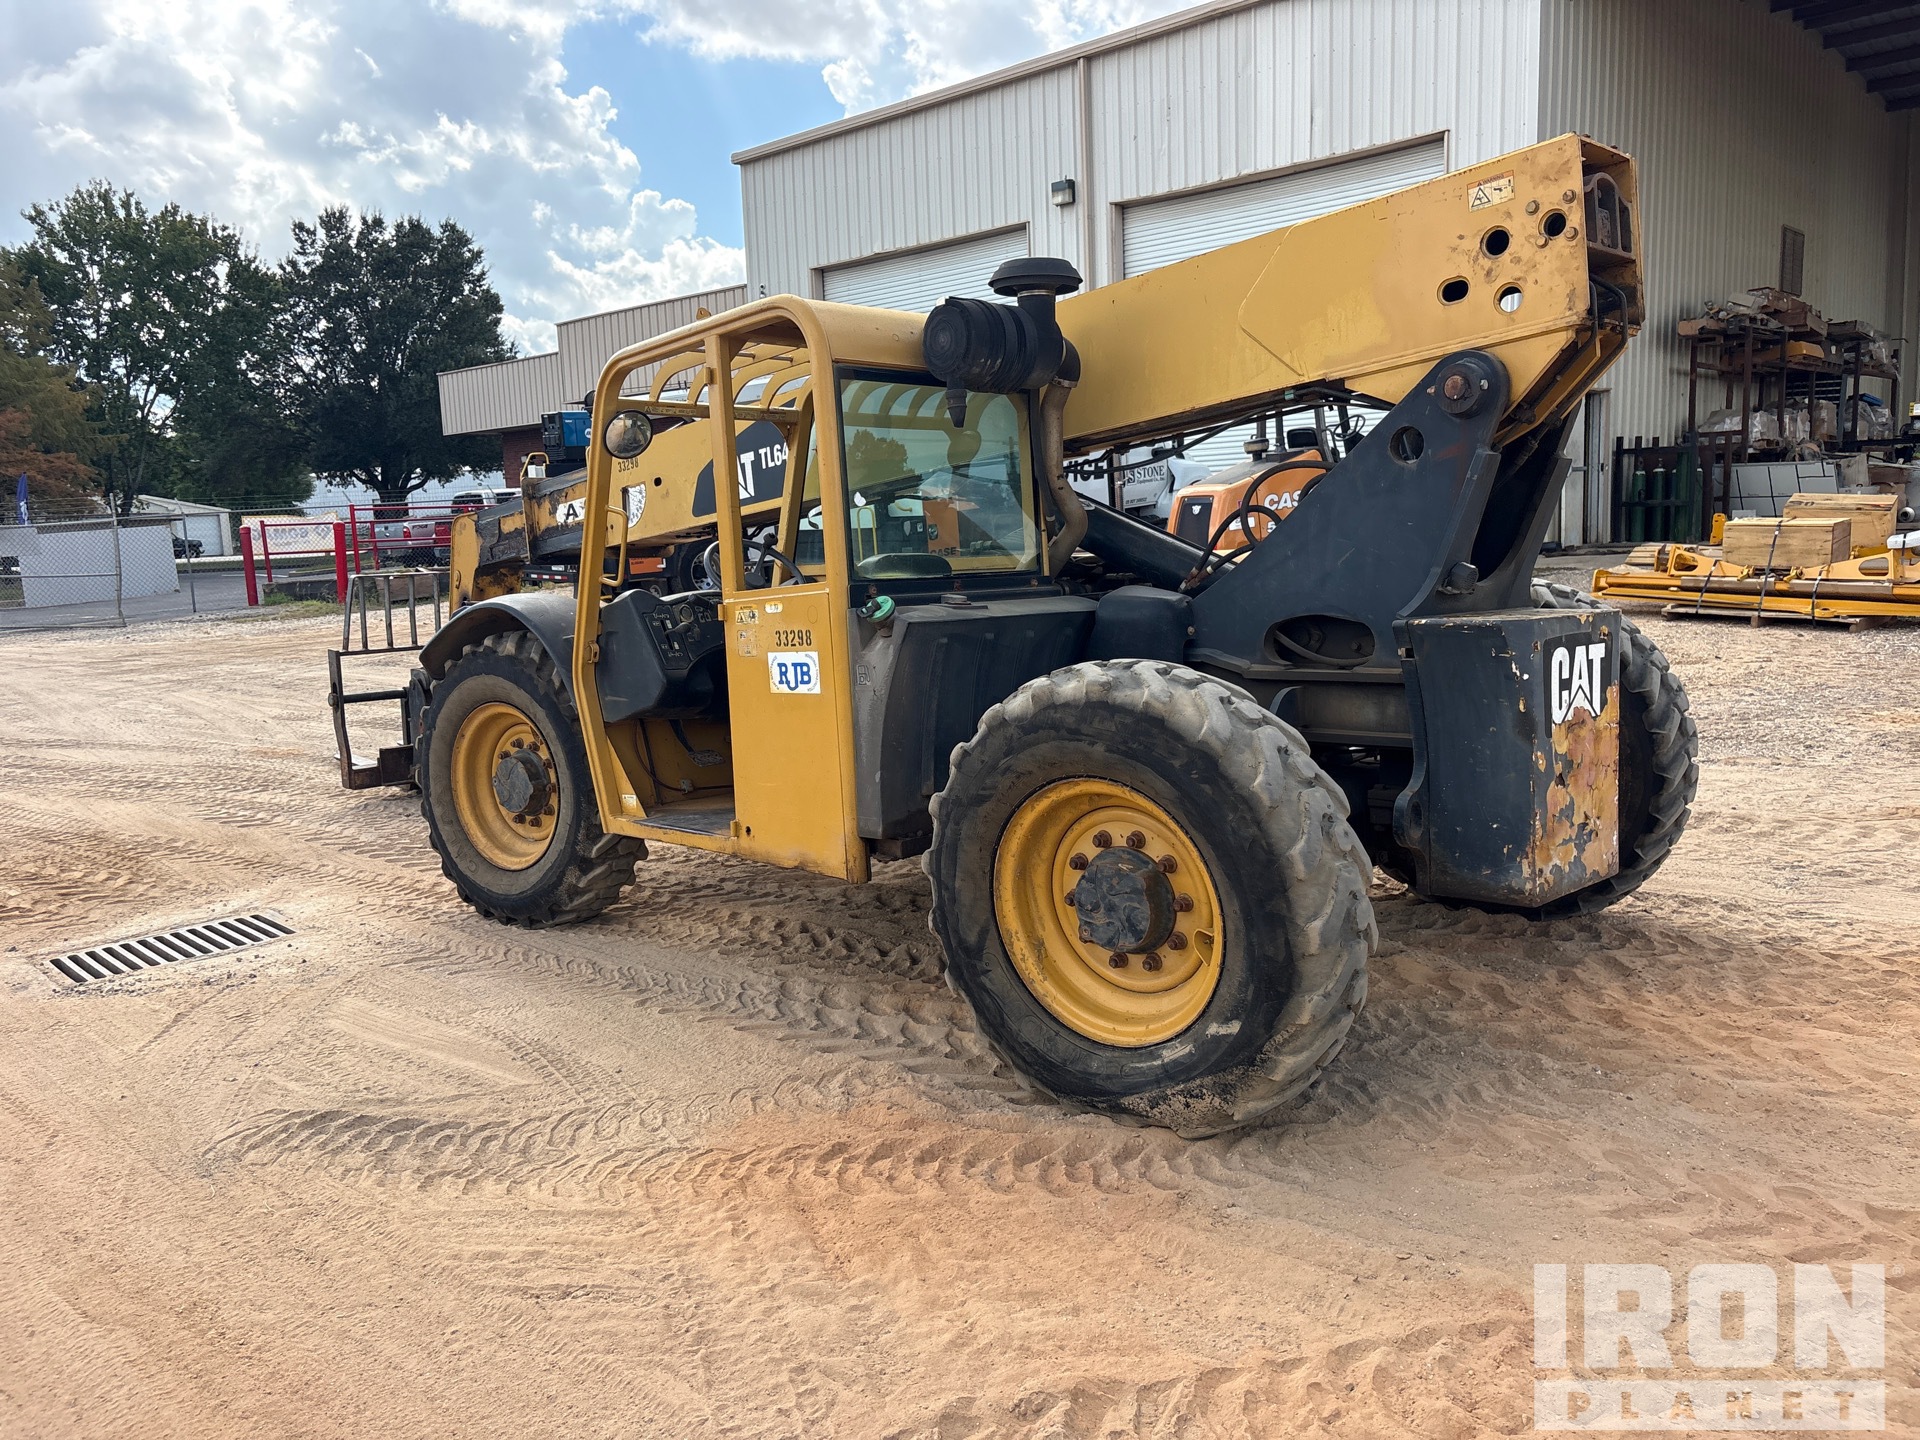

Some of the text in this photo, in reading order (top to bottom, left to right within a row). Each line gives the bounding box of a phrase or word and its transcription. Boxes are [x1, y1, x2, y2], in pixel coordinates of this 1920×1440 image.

[617, 457, 639, 473] 33298
[1136, 465, 1165, 479] STONE
[774, 629, 813, 647] 33298
[777, 662, 812, 692] RJB
[1551, 642, 1606, 725] CAT
